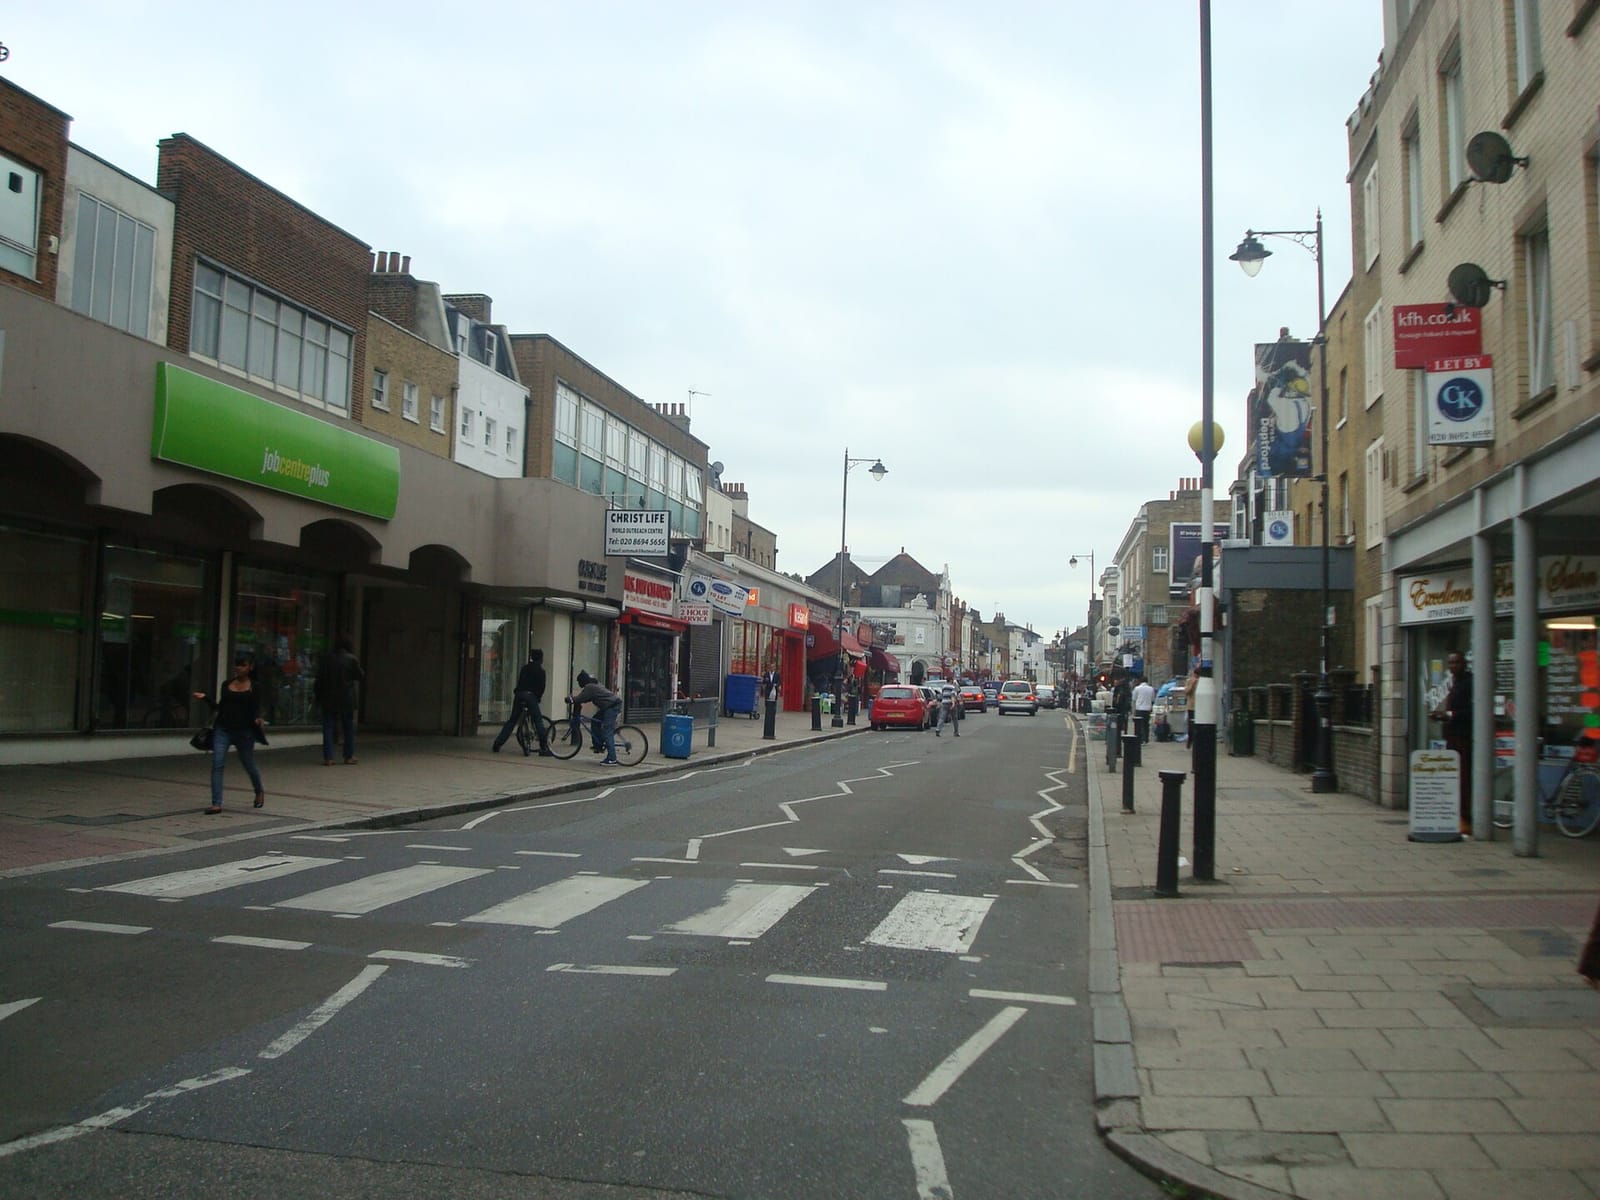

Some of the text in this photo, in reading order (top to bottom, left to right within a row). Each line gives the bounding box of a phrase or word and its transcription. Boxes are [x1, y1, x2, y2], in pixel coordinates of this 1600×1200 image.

[1434, 357, 1482, 371] LET BY
[1442, 385, 1477, 409] CK
[1259, 417, 1272, 471] Deptford
[261, 446, 331, 488] jobcentreplus
[610, 513, 665, 523] CHRIST LIFE
[648, 527, 663, 535] CENTRE
[608, 537, 619, 545] Tel:
[620, 538, 632, 546] 020
[686, 609, 709, 617] HOUR
